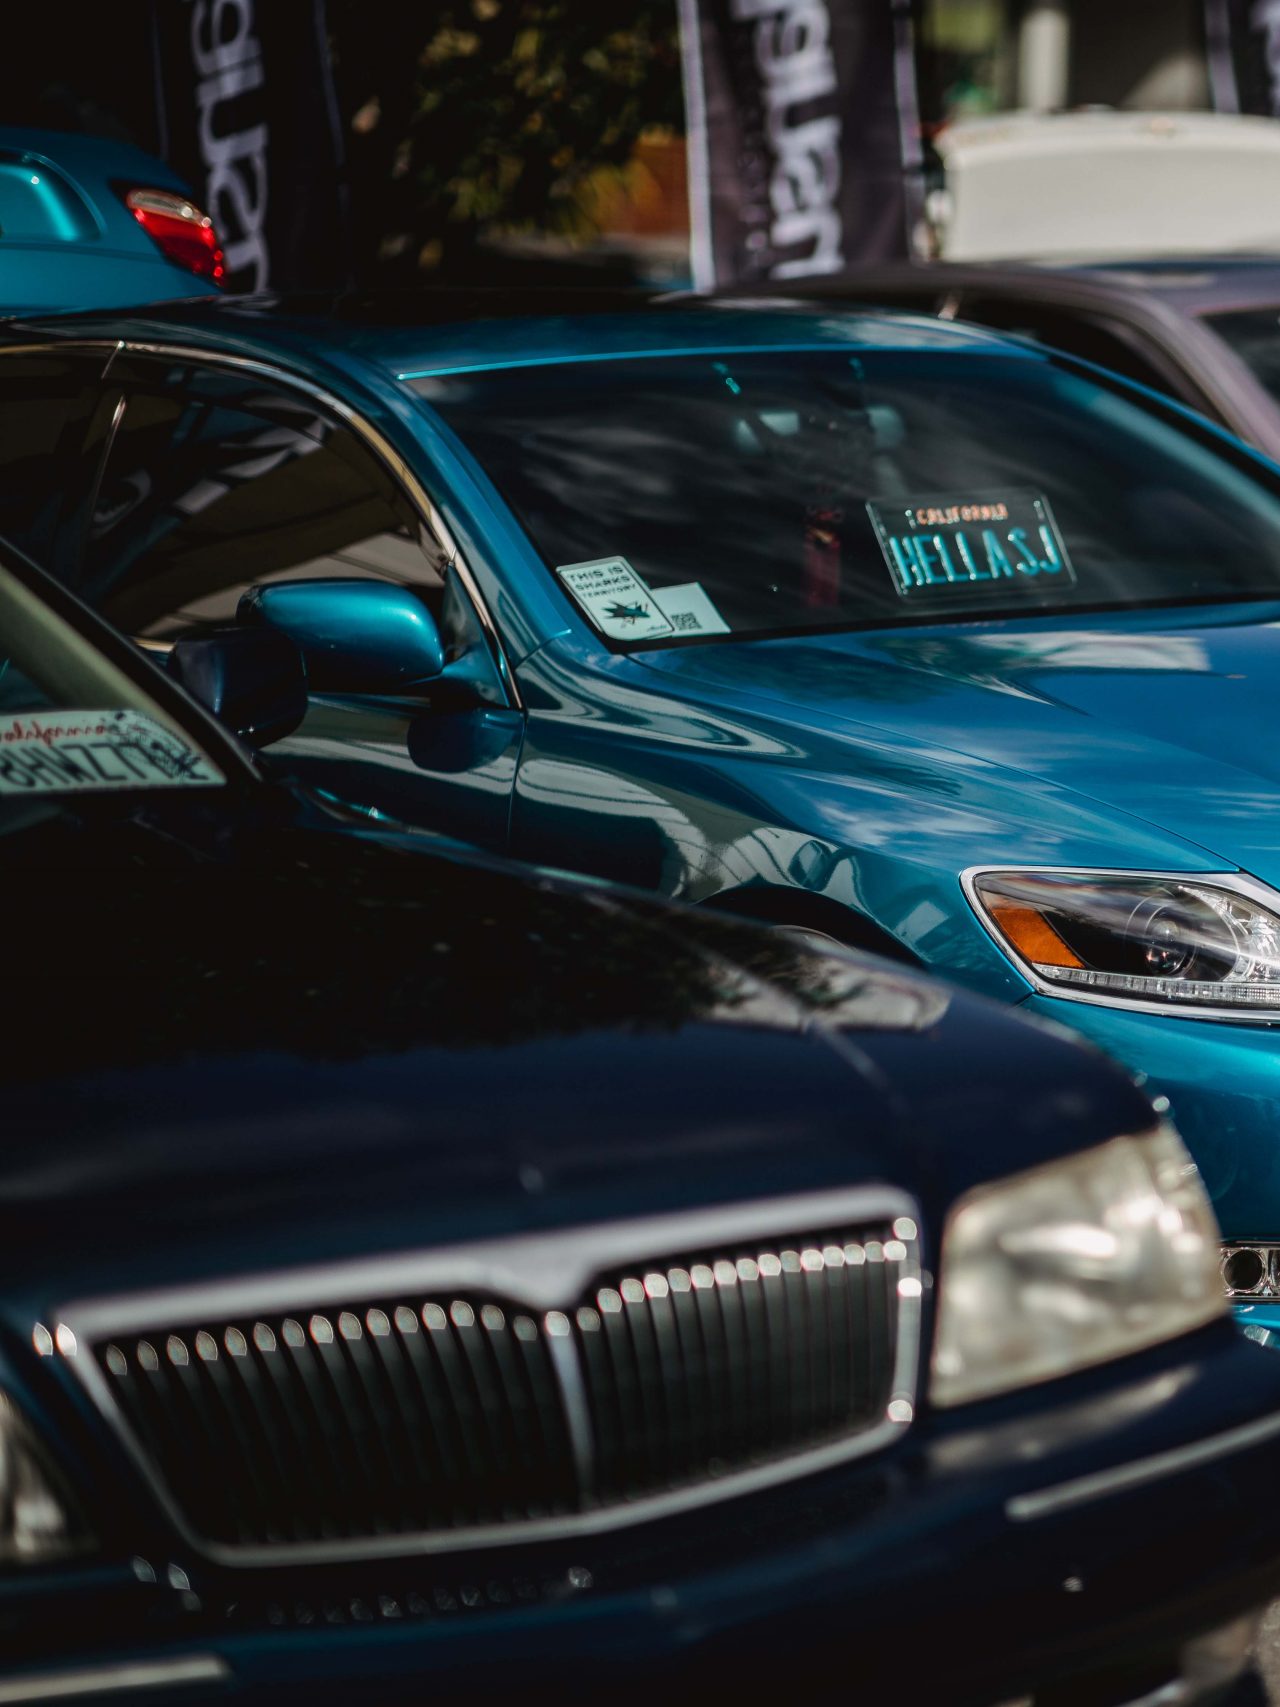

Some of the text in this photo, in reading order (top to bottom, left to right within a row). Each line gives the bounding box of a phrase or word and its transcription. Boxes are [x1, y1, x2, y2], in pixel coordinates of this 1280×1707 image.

[915, 503, 1009, 525] CALIFORNIA
[568, 566, 624, 582] THIS IS
[575, 575, 631, 591] SHARKS
[582, 583, 637, 598] TERRITORY
[0, 721, 107, 745] alifornia
